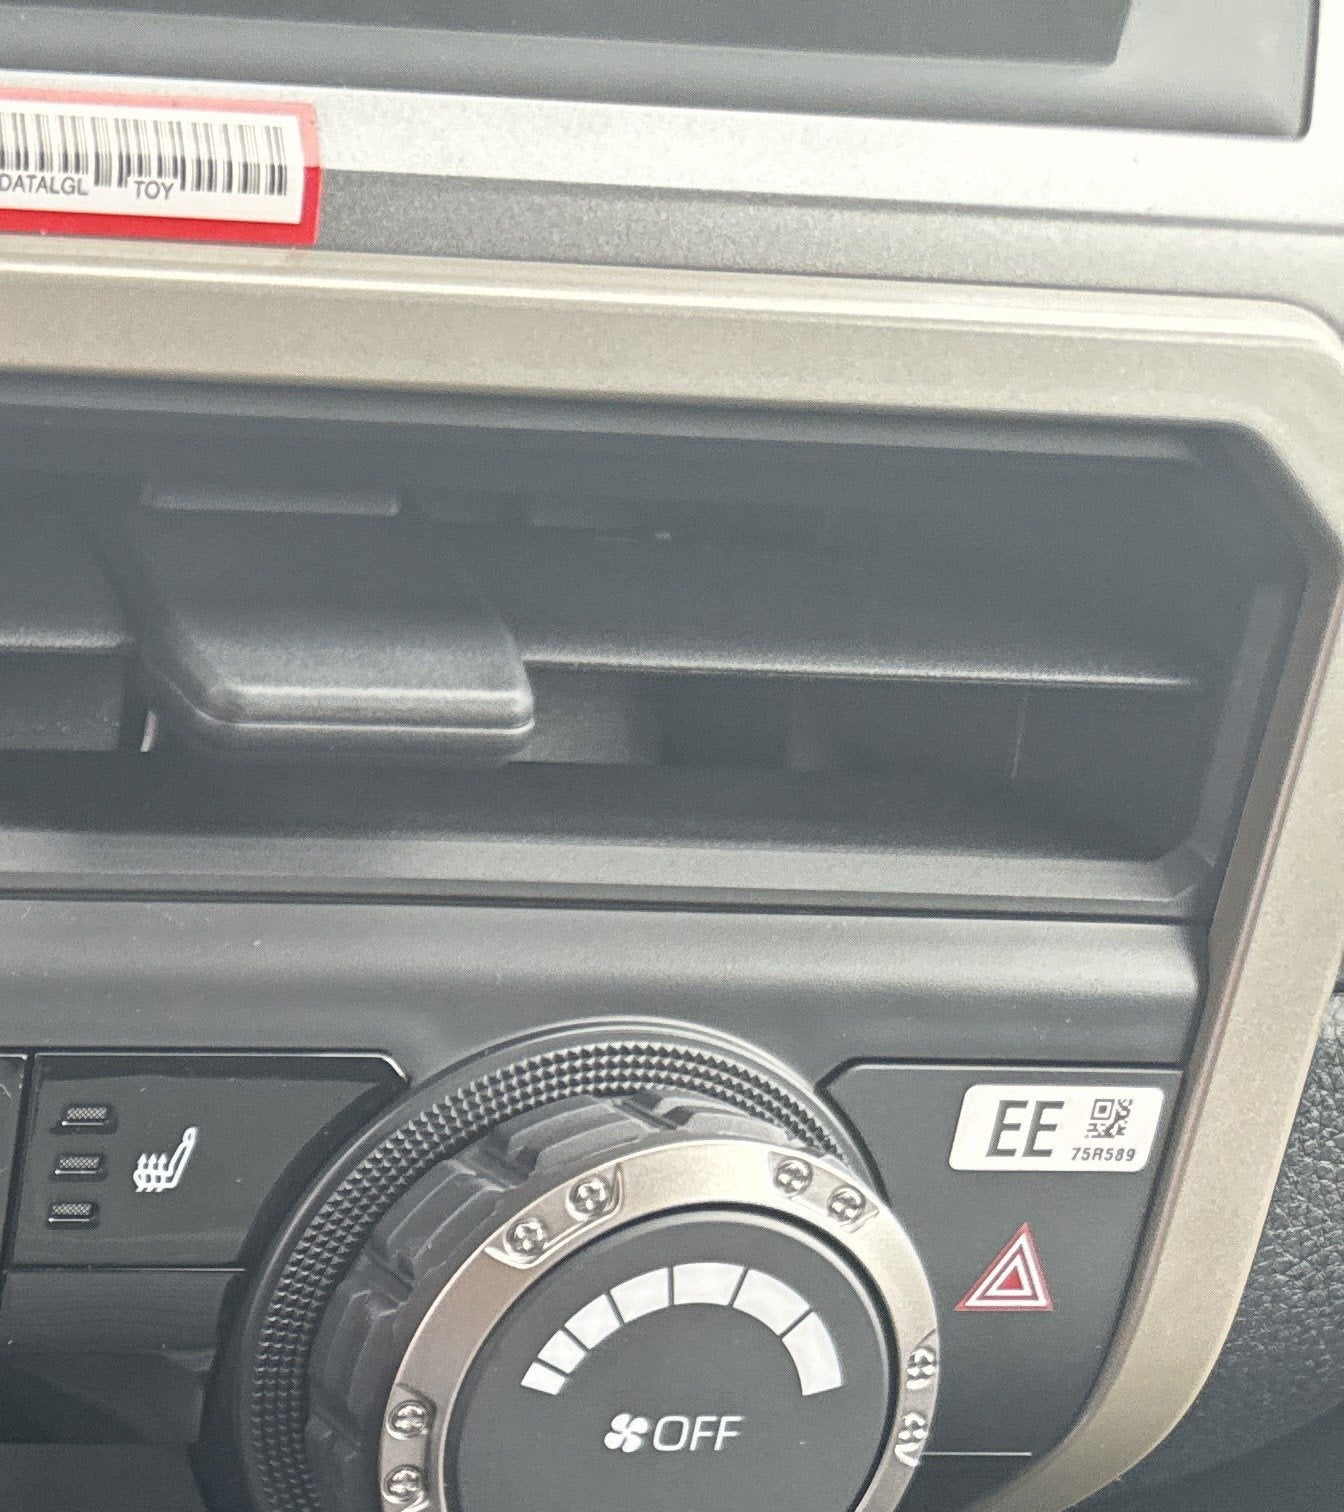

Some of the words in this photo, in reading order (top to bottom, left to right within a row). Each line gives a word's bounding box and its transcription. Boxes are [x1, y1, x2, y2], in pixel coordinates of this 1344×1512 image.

[134, 180, 175, 200] TOY
[985, 1099, 1066, 1158] EE
[653, 1415, 745, 1452] OFF
